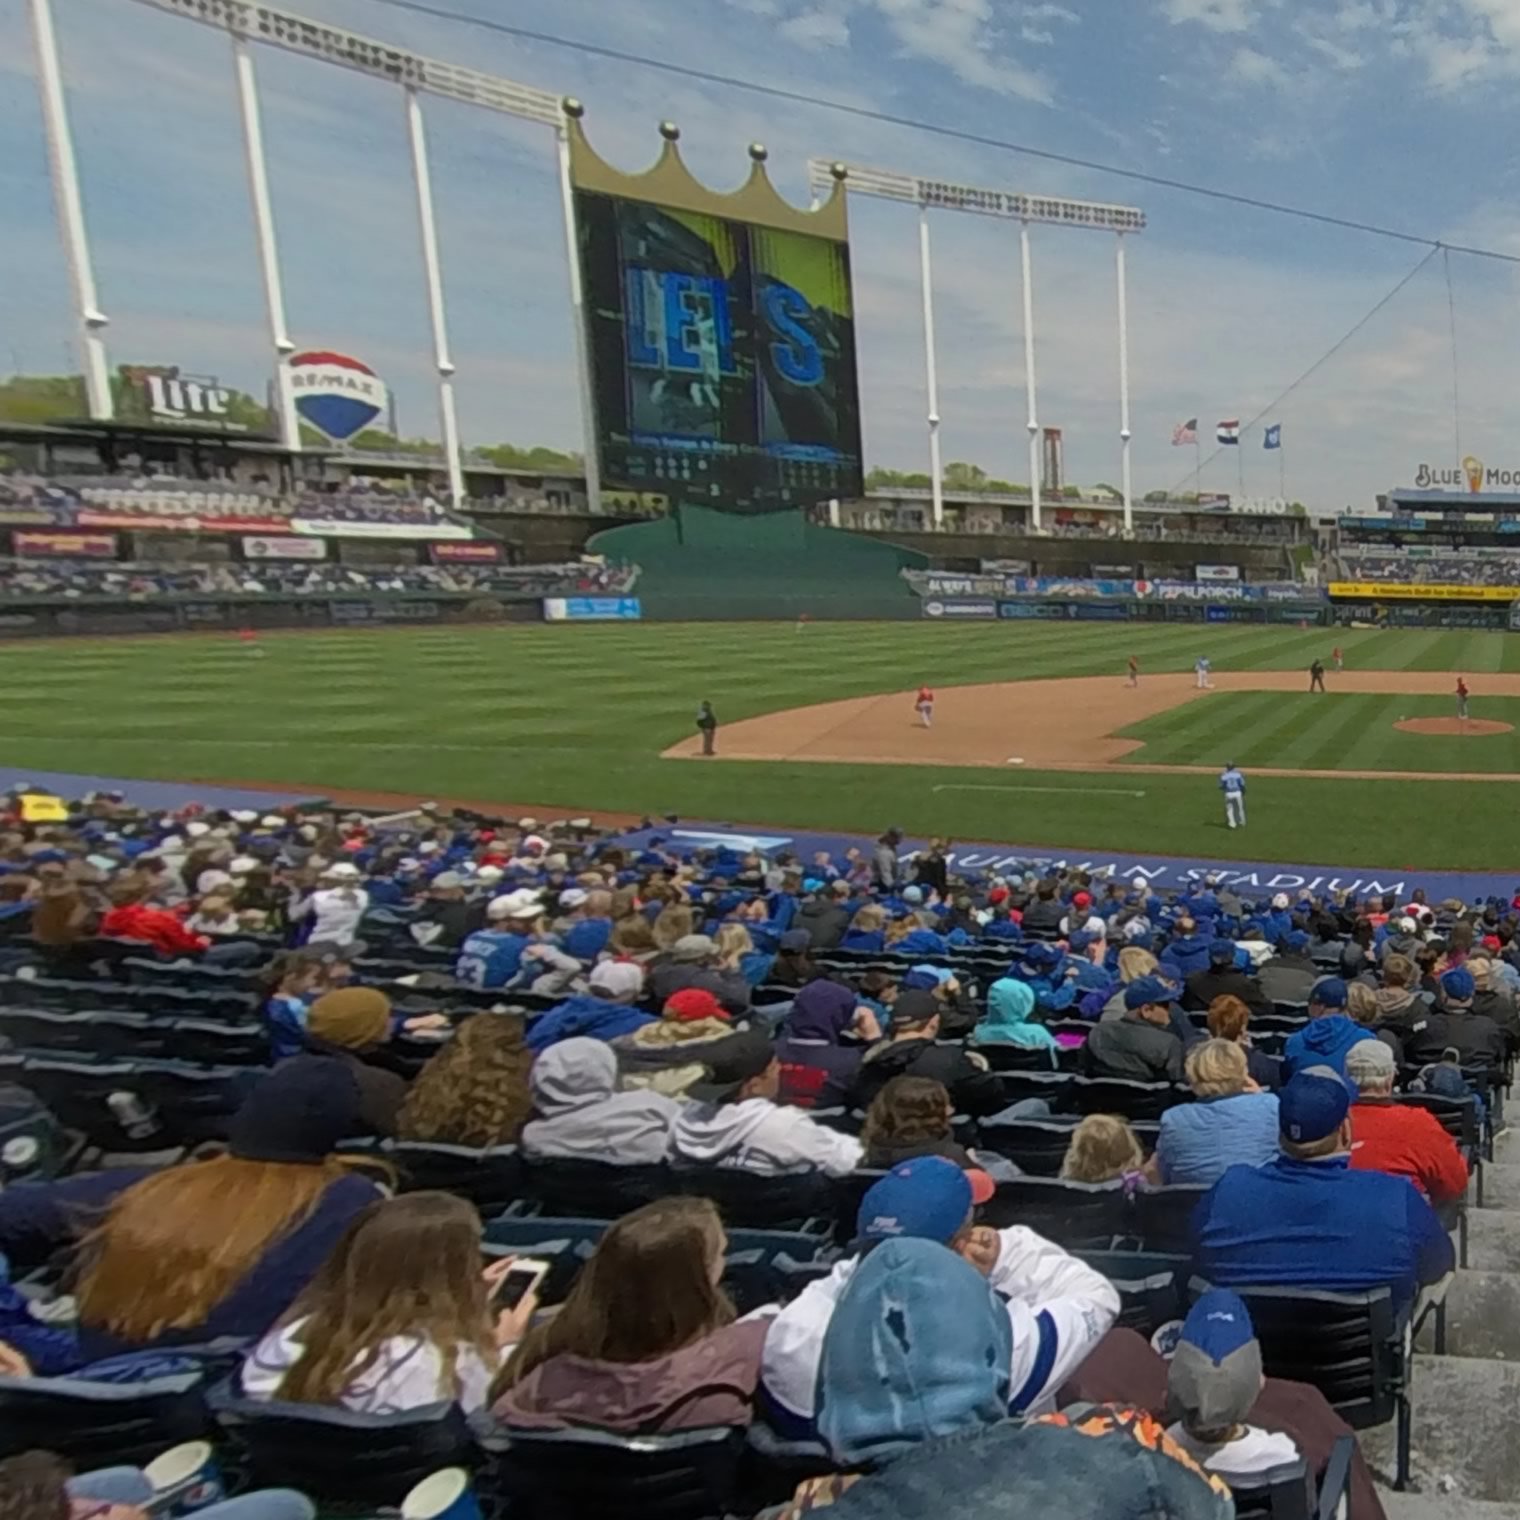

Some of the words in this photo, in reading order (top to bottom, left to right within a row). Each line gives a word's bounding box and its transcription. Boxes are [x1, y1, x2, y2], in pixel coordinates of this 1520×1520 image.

[147, 375, 229, 418] Lite
[291, 373, 374, 396] RE/MAX
[1415, 464, 1461, 487] BLUE
[1177, 867, 1404, 895] STADIUM
